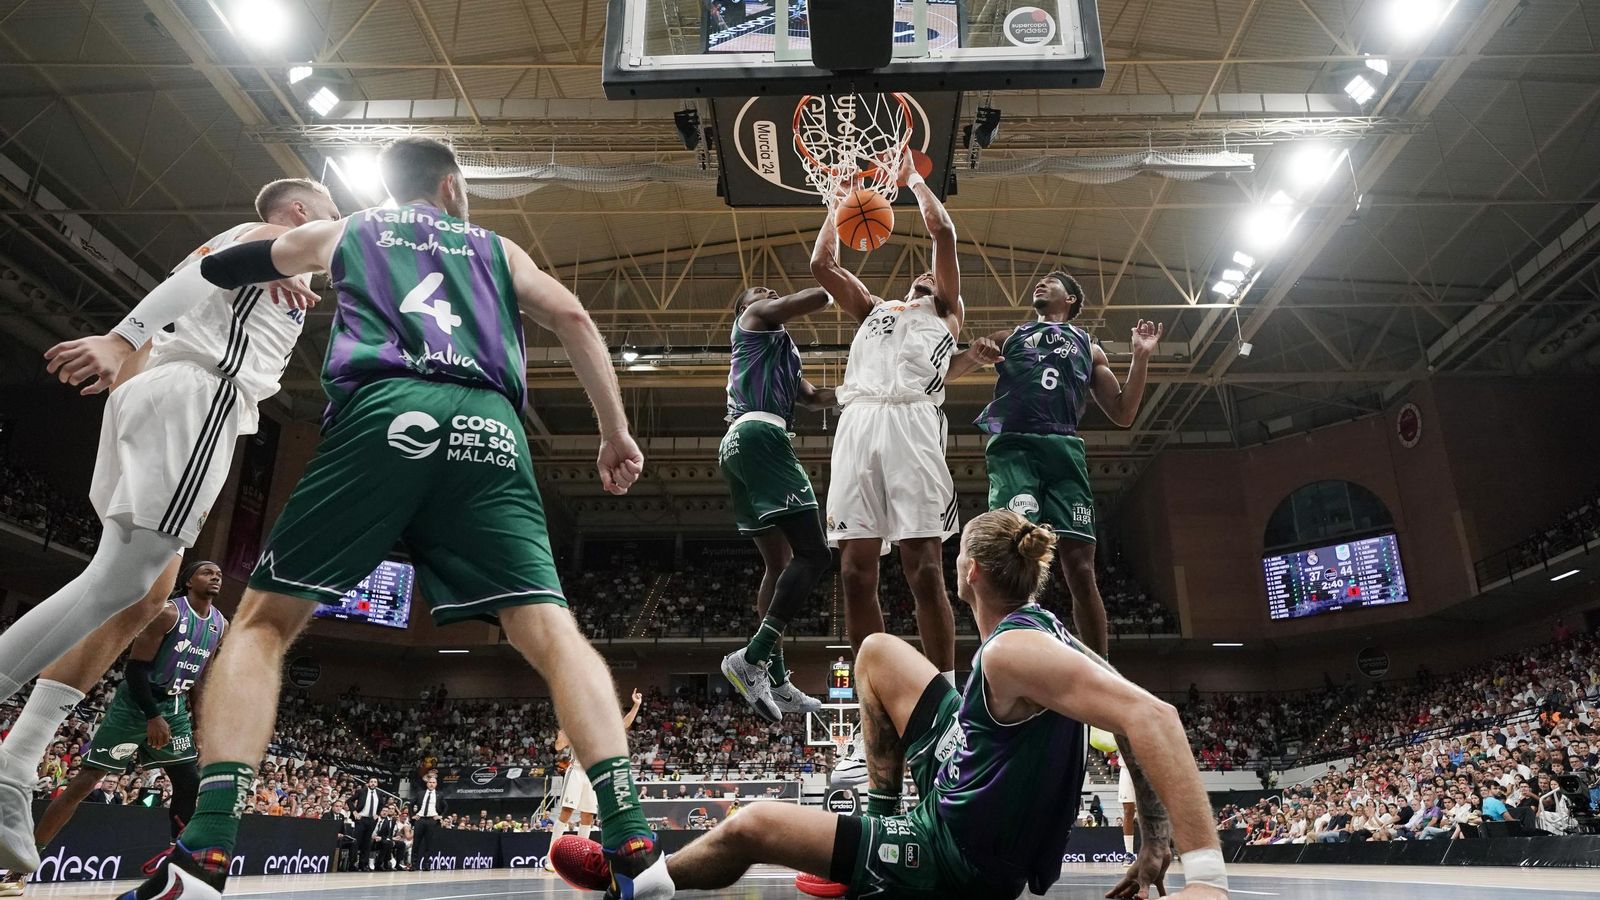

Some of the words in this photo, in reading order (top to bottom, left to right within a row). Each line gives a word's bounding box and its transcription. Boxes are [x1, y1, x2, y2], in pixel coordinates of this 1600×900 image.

[757, 124, 771, 160] Murcia
[761, 161, 774, 174] '24
[364, 208, 487, 238] Kalinoski
[399, 272, 462, 335] 4
[1041, 367, 1059, 390] 6
[451, 414, 517, 446] COSTA
[449, 433, 485, 448] DEL
[488, 436, 519, 458] SOL
[446, 448, 517, 471] MÁLAGA
[1309, 571, 1320, 582] 37
[1340, 565, 1353, 576] 44
[1321, 579, 1344, 590] 2:40
[836, 677, 849, 688] 13
[264, 848, 330, 875] endesa
[462, 852, 493, 869] endesa
